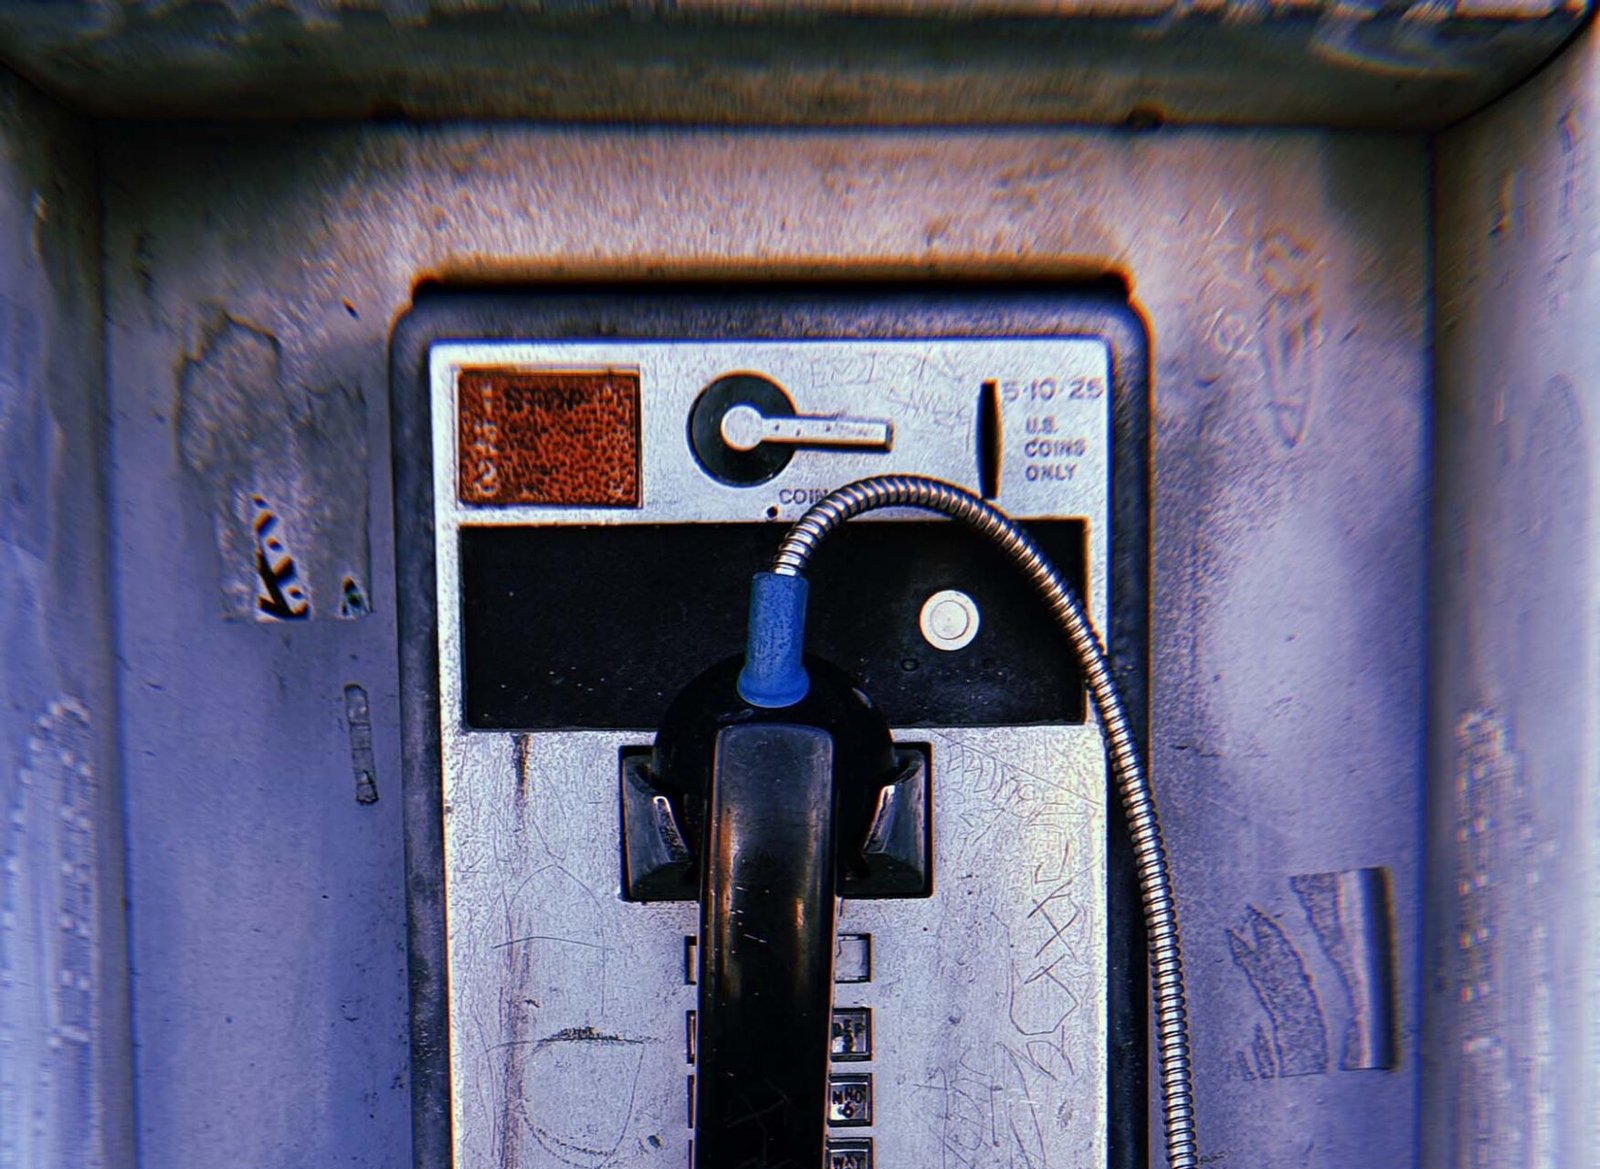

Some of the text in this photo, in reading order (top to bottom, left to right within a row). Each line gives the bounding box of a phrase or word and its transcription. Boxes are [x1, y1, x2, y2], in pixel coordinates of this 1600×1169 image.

[1025, 437, 1087, 458] COINS
[1025, 464, 1078, 482] ONLY
[843, 1101, 854, 1118] 6
